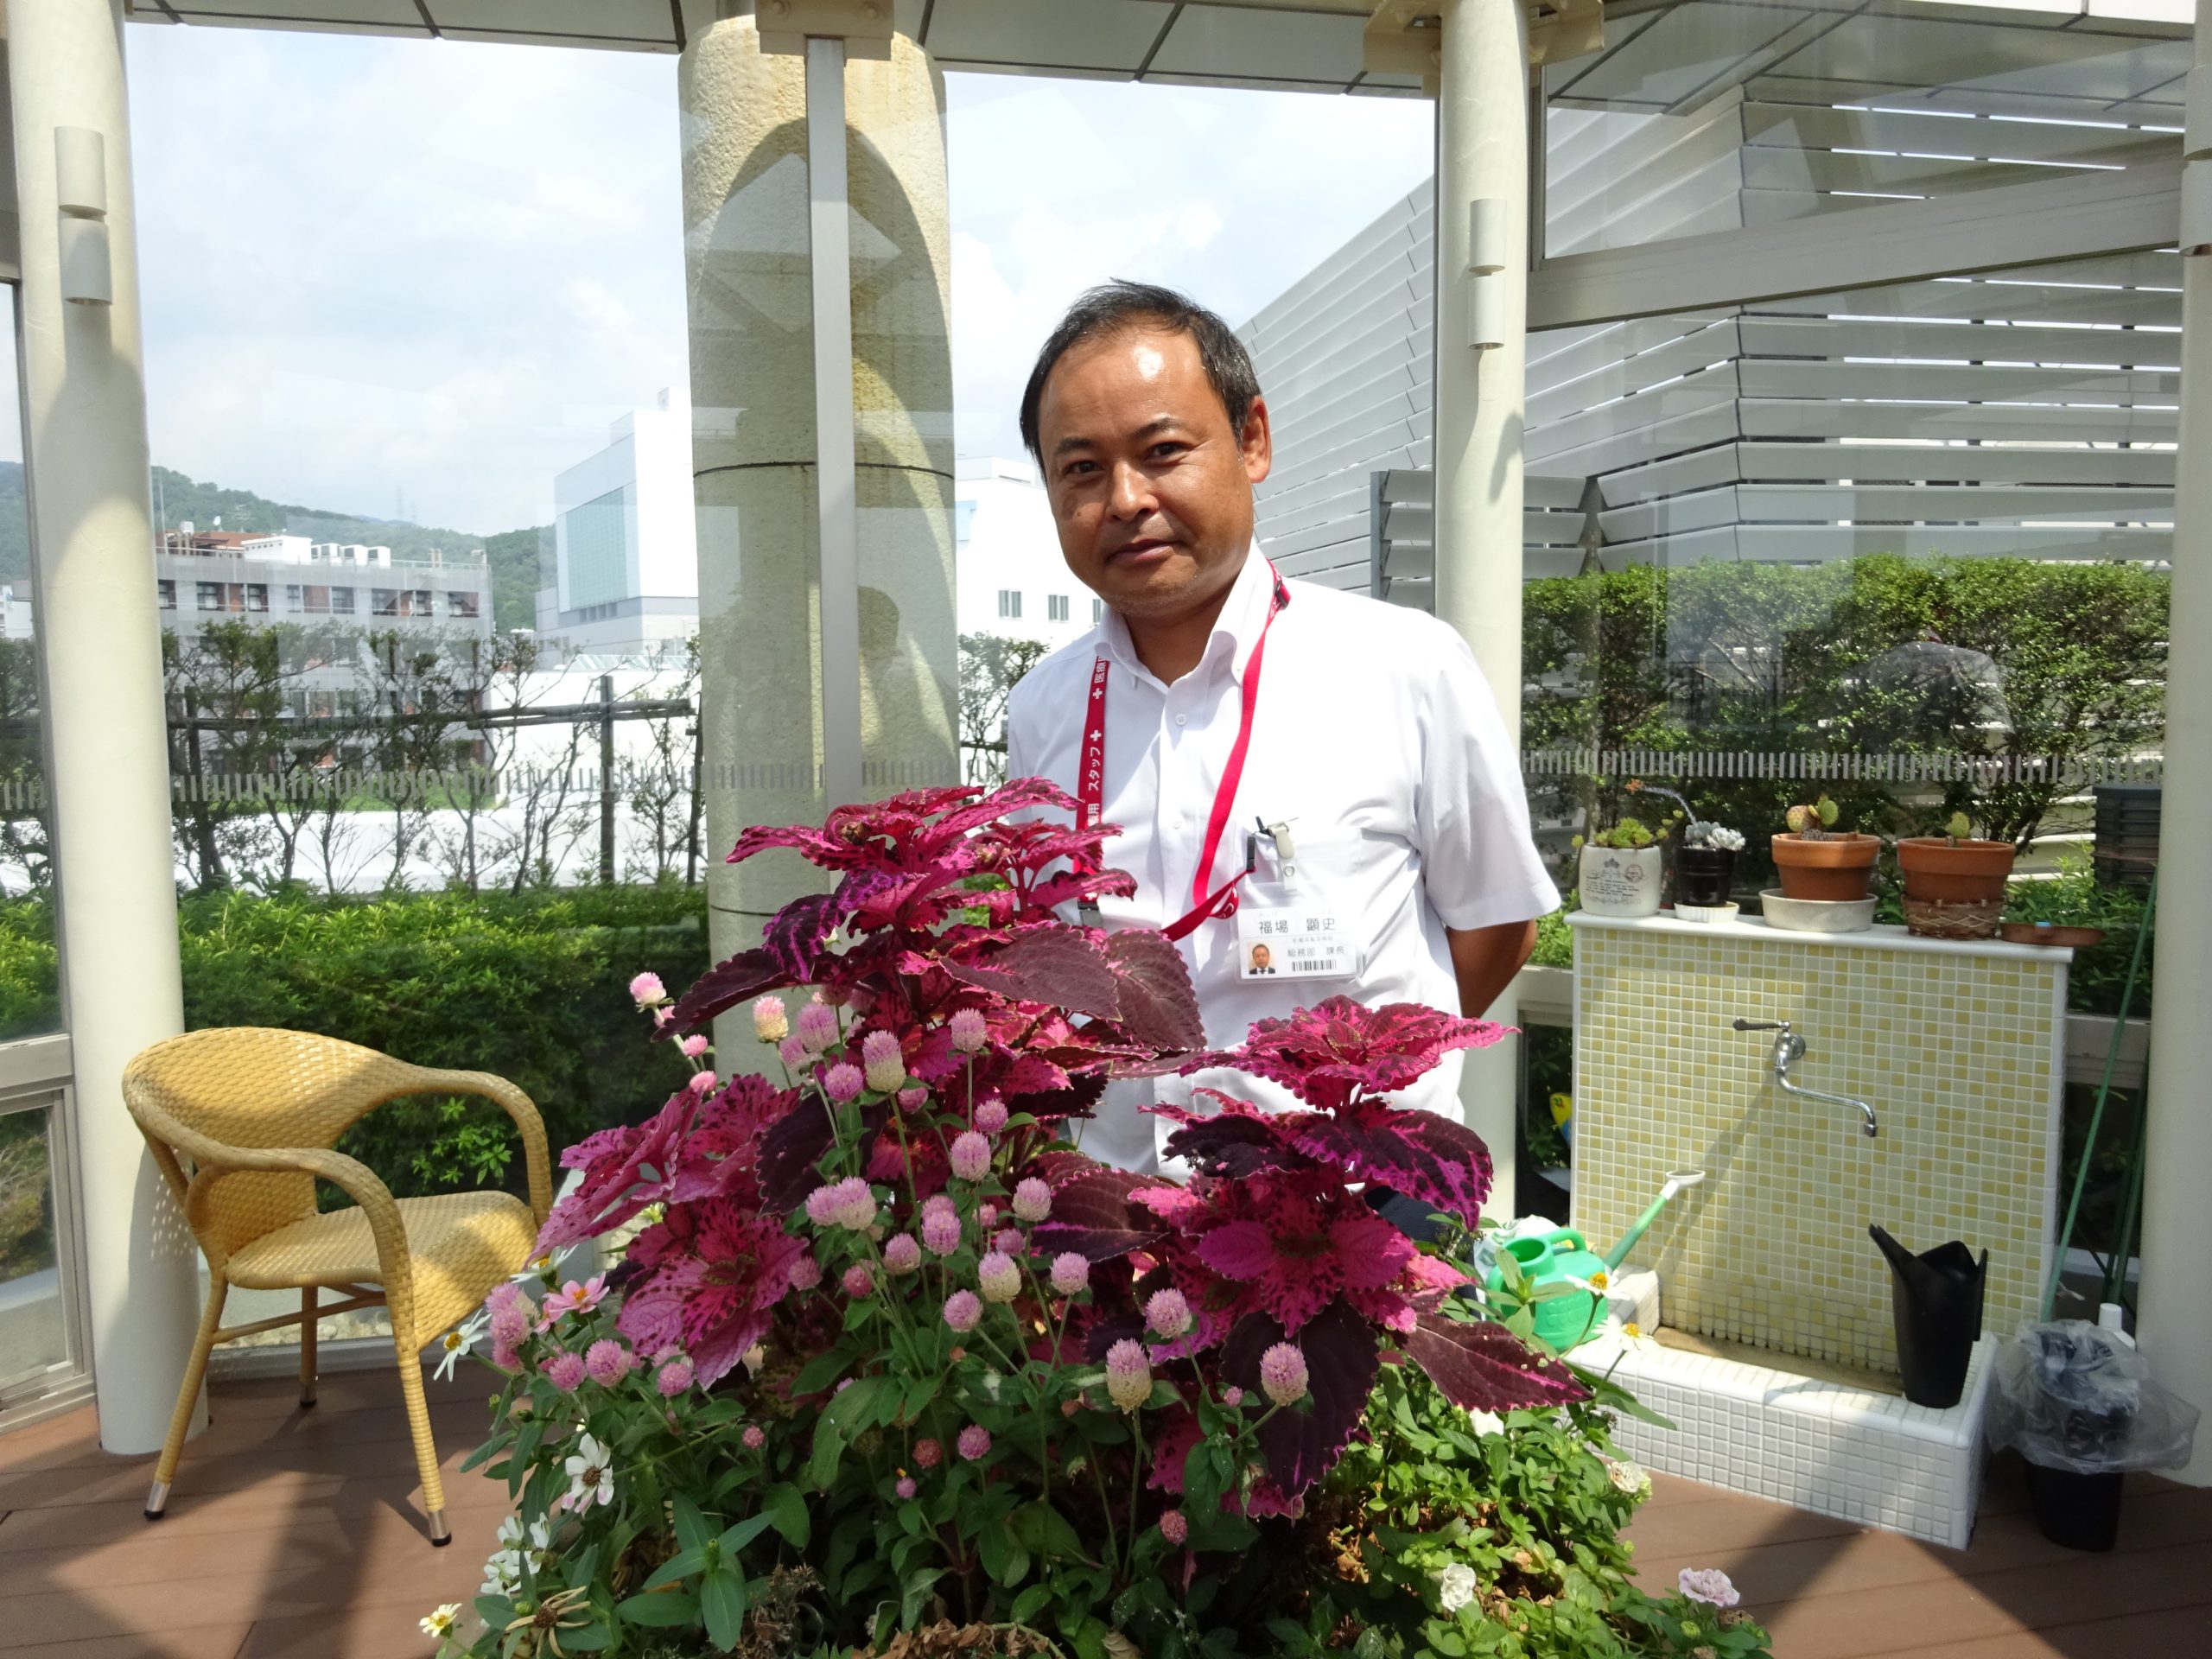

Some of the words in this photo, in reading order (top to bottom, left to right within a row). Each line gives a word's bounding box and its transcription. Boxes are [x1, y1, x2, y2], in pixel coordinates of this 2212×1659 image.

[1088, 747, 1101, 791] スタッフ
[1259, 919, 1288, 934] 福場
